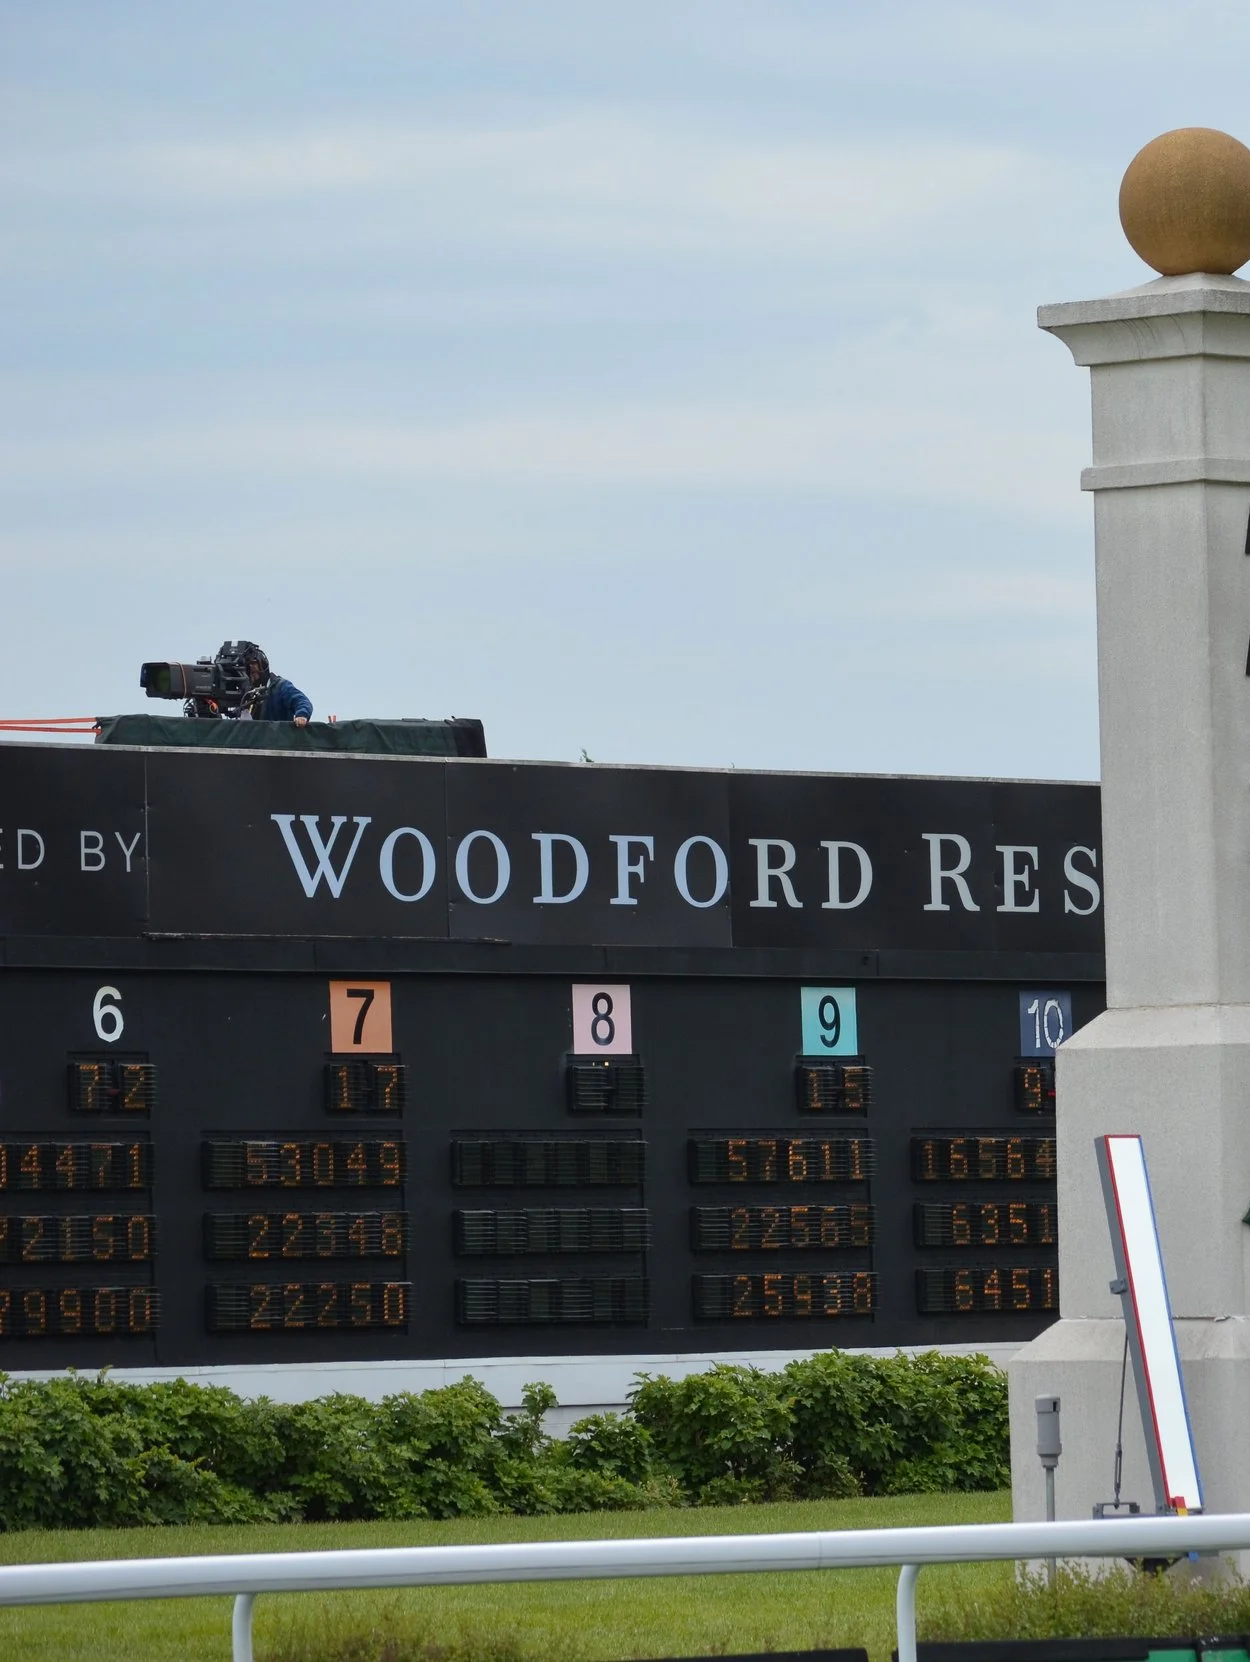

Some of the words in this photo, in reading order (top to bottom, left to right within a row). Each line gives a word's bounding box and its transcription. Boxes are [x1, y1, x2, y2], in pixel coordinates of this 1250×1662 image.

[80, 830, 141, 873] BY
[271, 814, 873, 910] WOODFORD
[93, 986, 124, 1042] 6
[346, 988, 375, 1045] 7
[591, 991, 615, 1046] 8
[818, 995, 842, 1048] 9
[1027, 998, 1064, 1048] 10
[727, 1137, 863, 1182] 57611
[250, 1283, 404, 1329] 22250
